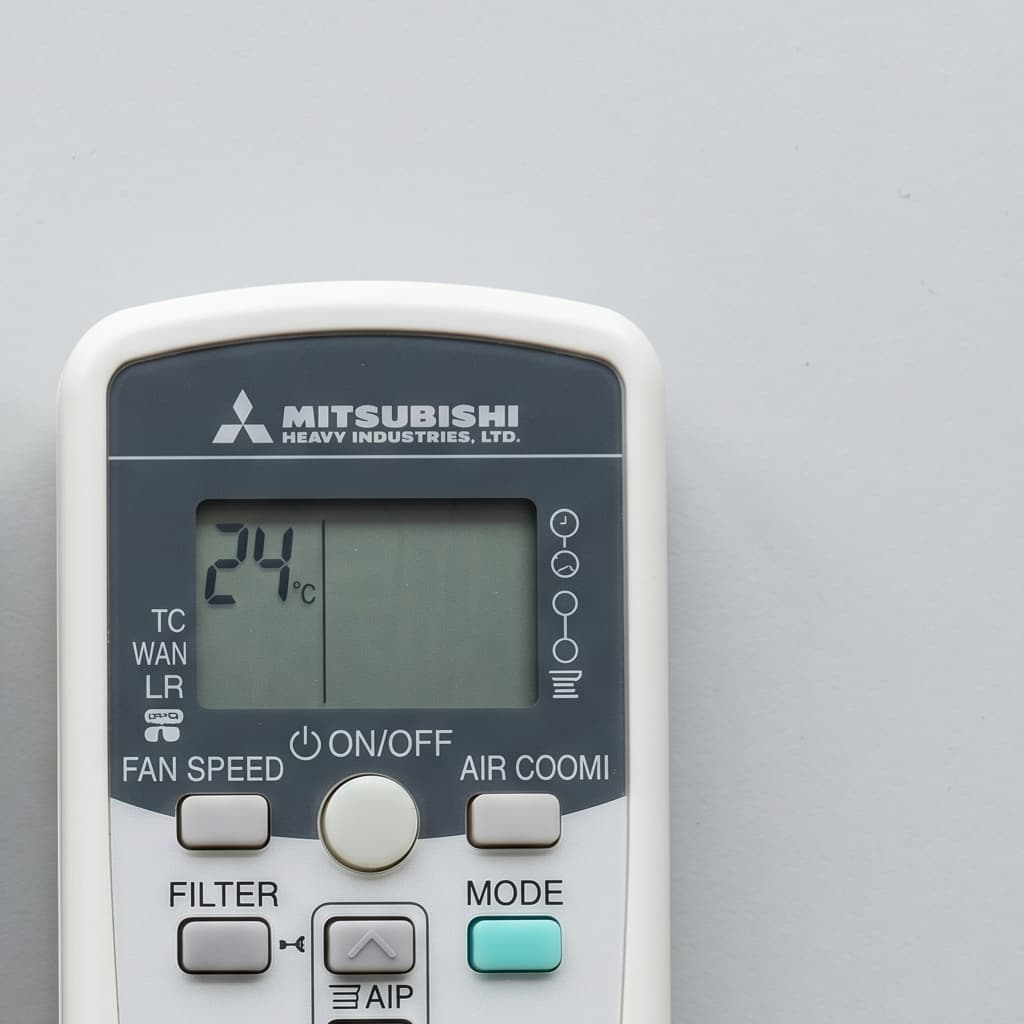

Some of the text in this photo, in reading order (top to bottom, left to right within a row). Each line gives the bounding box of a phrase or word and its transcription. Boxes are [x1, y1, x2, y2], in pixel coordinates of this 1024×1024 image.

[282, 405, 519, 428] MITSUBISHI
[282, 429, 521, 446] HEAVY INDUSTRIES, LTD.
[204, 523, 294, 605] 24
[151, 609, 185, 633] TC
[133, 642, 187, 665] WAN
[145, 675, 183, 698] LR
[328, 729, 453, 757] ON/OFF
[122, 756, 284, 782] FAN SPEED
[460, 755, 609, 781] AIR COOMI
[170, 881, 279, 908] FILTER
[467, 880, 563, 905] MODE
[366, 985, 413, 1009] AIP
